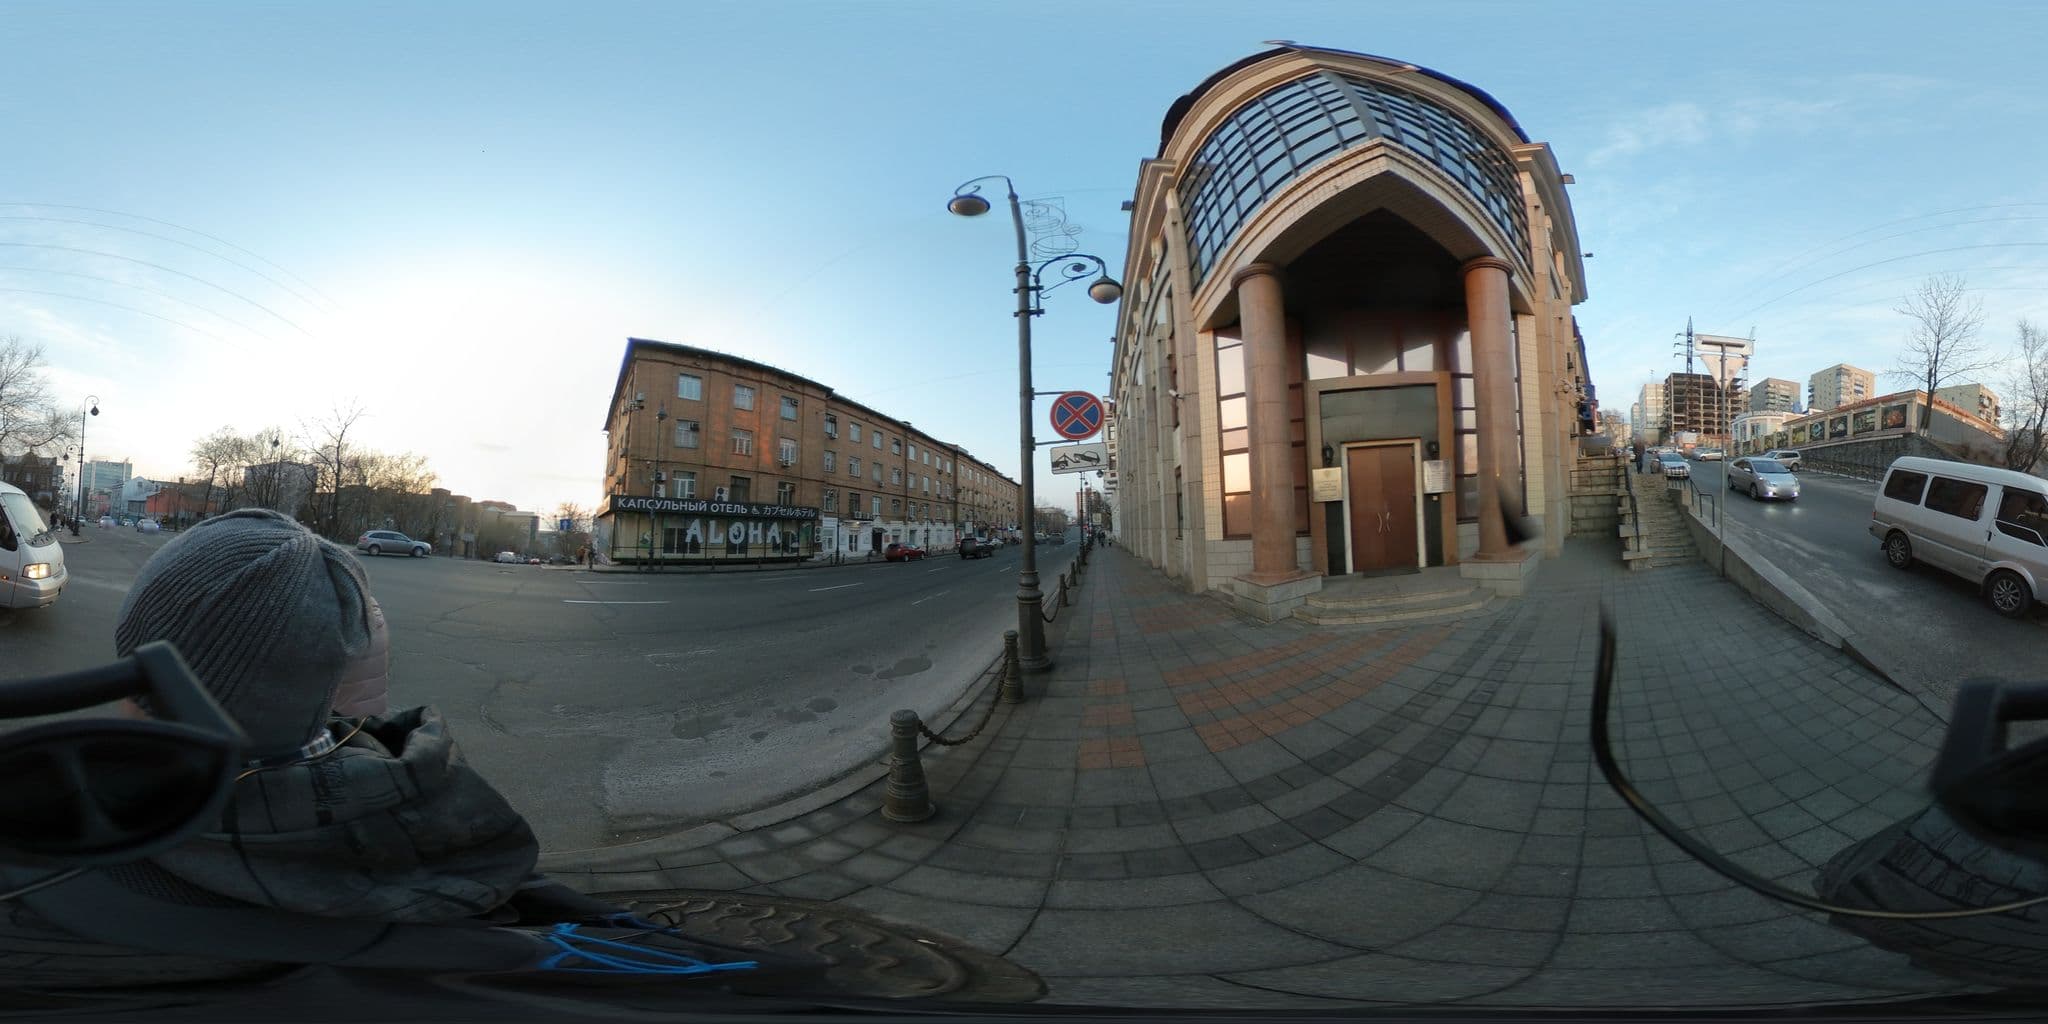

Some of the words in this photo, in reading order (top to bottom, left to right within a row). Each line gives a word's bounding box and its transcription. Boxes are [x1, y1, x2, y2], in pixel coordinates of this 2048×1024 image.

[617, 498, 708, 512] КАПСУЛЬНЫЙ
[710, 503, 748, 514] ОТЕЛЬ
[685, 519, 782, 545] ALOHA
